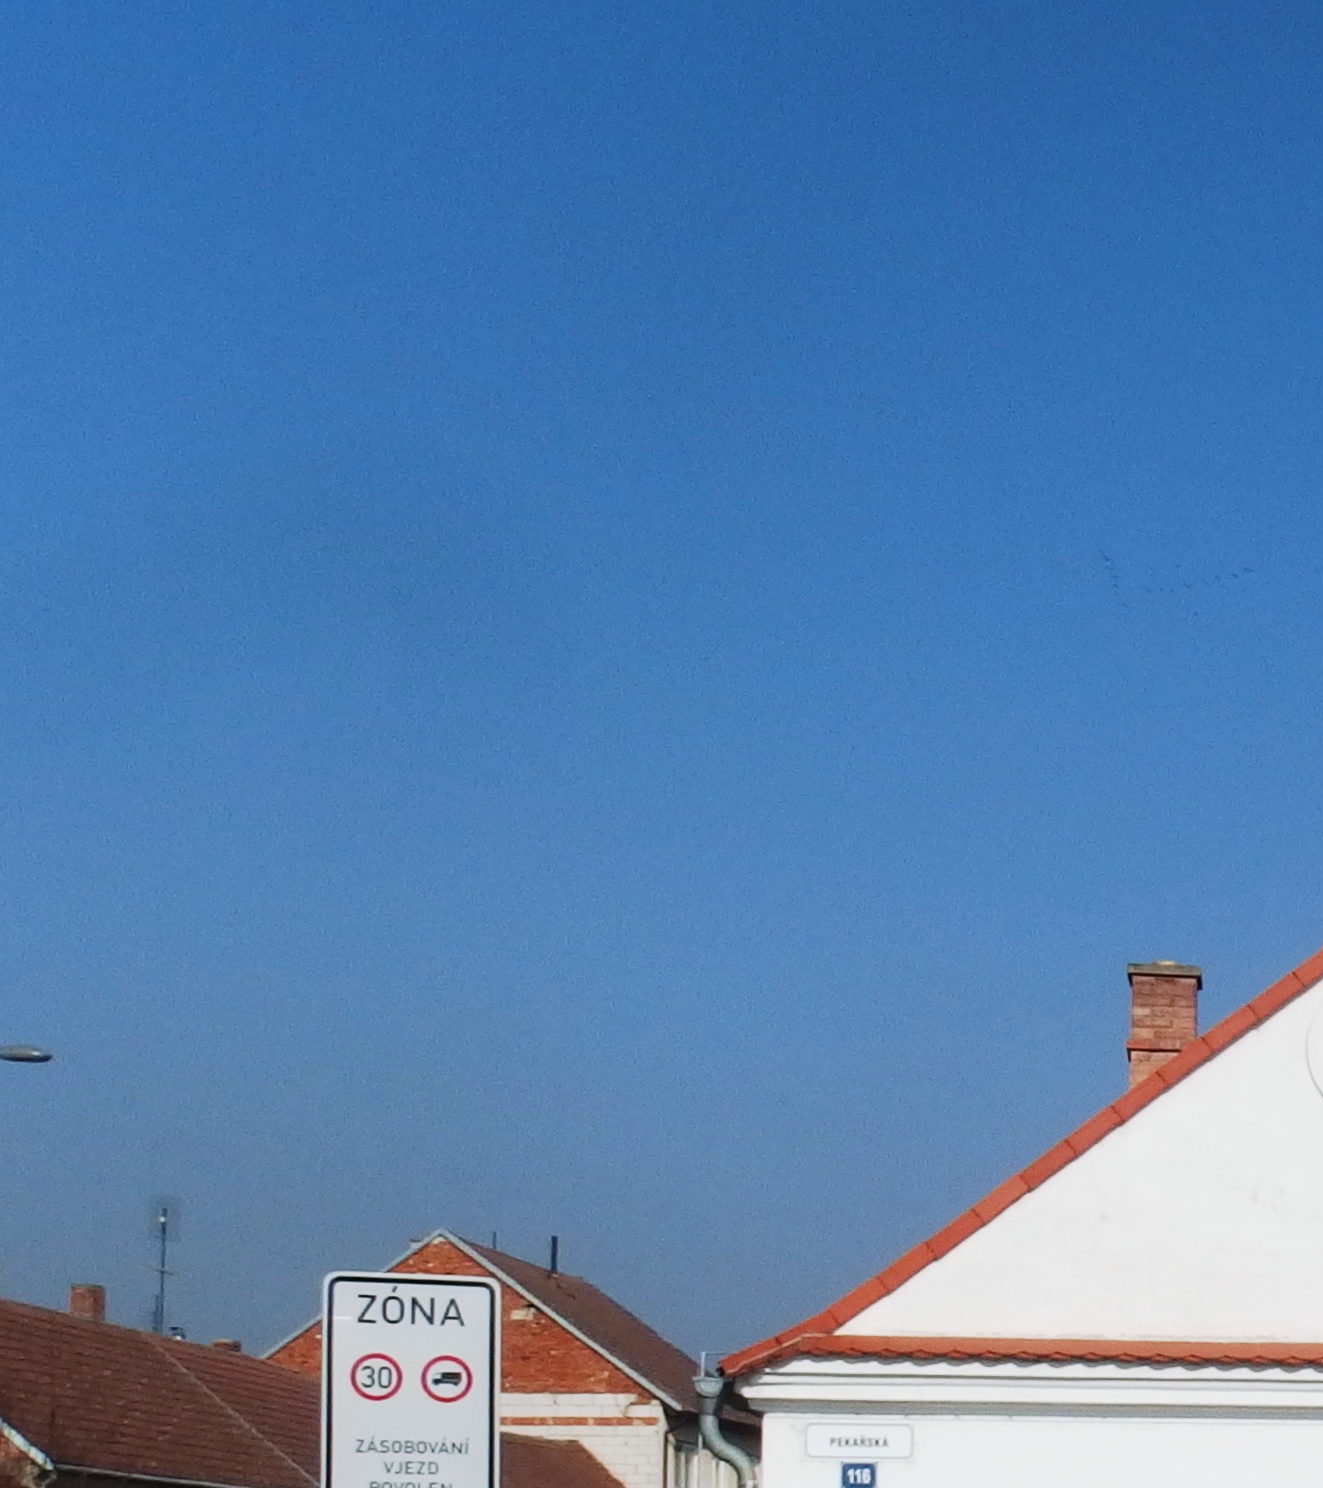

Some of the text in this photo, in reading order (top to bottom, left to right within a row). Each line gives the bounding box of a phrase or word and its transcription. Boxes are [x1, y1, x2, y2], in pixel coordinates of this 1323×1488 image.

[357, 1286, 465, 1326] ZÓNA
[361, 1365, 393, 1389] 30
[355, 1435, 469, 1455] ZÁSOBOVÁNÍ
[384, 1461, 439, 1475] VJEZD
[847, 1468, 872, 1485] 116
